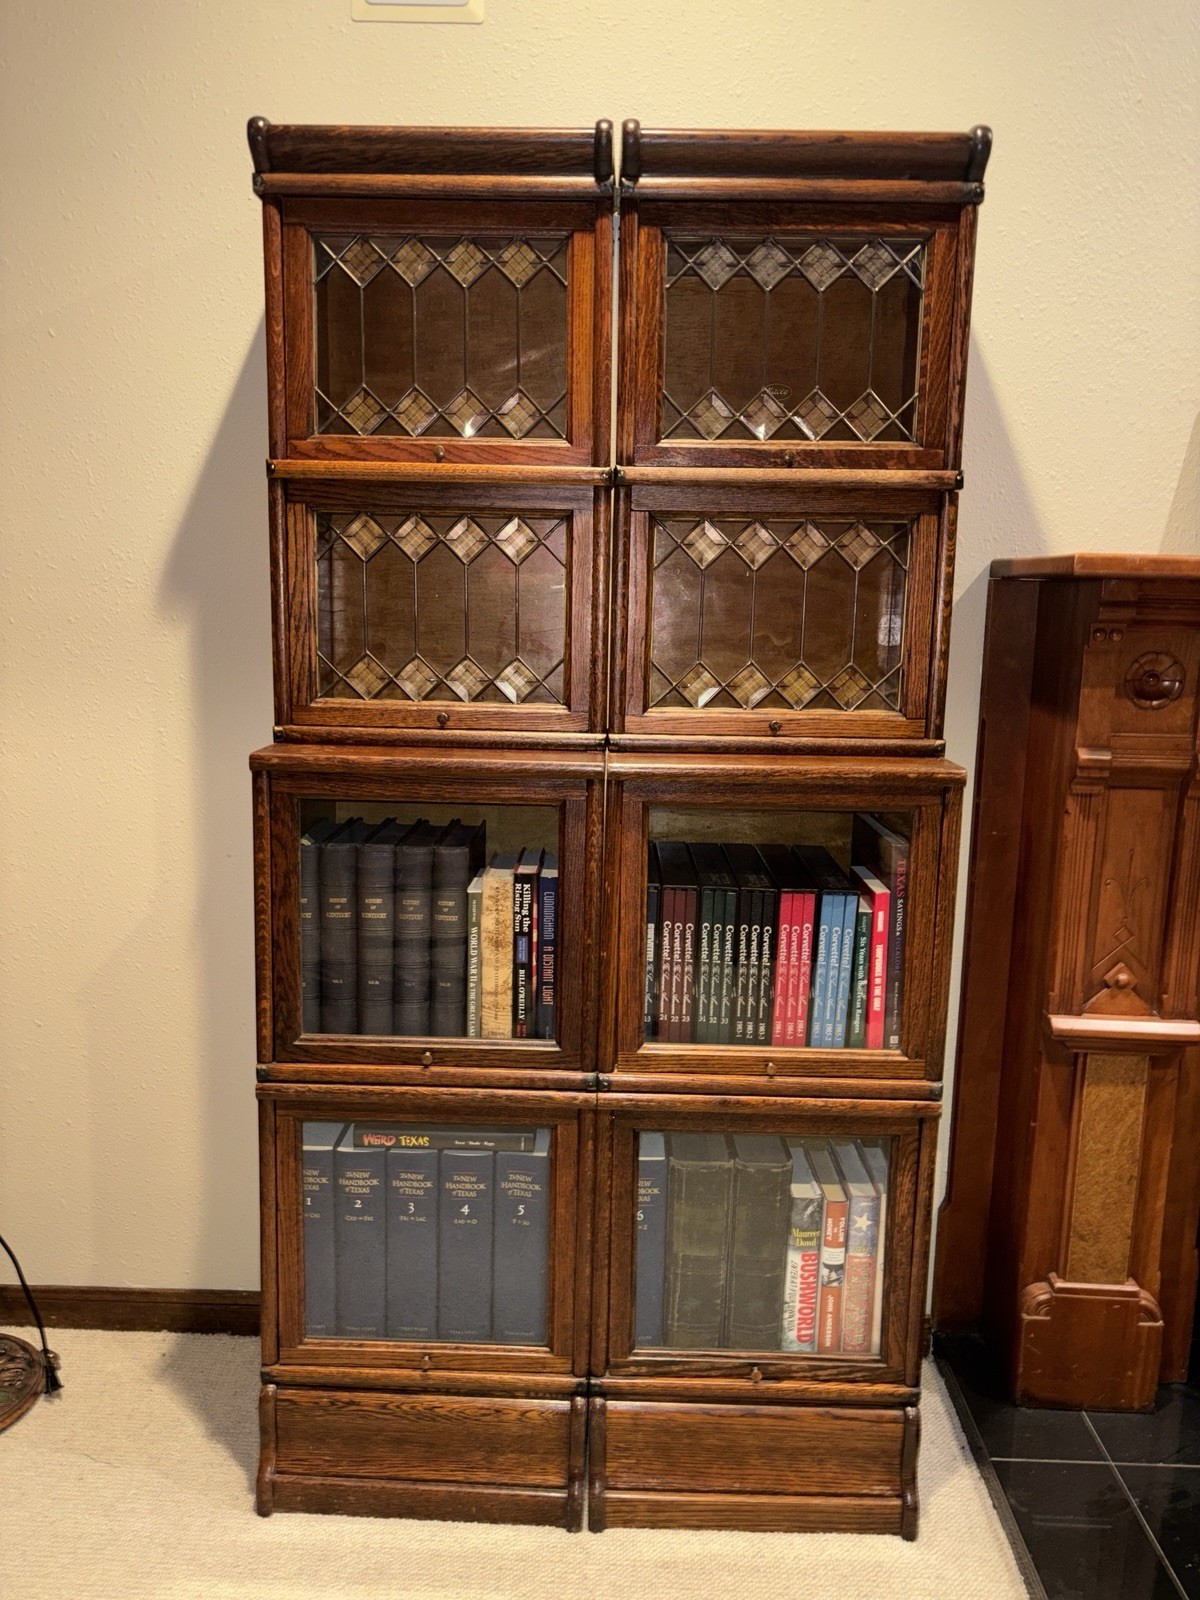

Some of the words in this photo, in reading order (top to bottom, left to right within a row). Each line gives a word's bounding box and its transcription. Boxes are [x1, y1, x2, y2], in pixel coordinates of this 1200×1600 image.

[896, 858, 906, 897] TEXAS
[522, 884, 530, 915] Killing
[543, 892, 554, 940] CUNNINGHAM
[663, 921, 672, 960] Corvette!
[674, 922, 683, 962] Corvette!
[685, 923, 694, 962] Corvette!
[702, 923, 710, 962] Corvette!
[713, 924, 722, 964] Corvette!
[725, 925, 734, 965] Corvette!
[740, 924, 749, 964] Corvette!
[750, 925, 760, 965] Corvette!
[762, 926, 772, 966] Corvette!
[780, 924, 789, 964] Corvette!
[790, 926, 800, 965] Corvette!
[801, 923, 811, 964] Corvette!
[818, 925, 828, 965] Corvette!
[830, 927, 841, 966] Corvette!
[842, 928, 852, 968] Corvette!
[543, 954, 554, 982] DISTANT
[543, 986, 553, 1005] LIGHT
[854, 1009, 862, 1033] Rangers
[398, 1135, 430, 1146] TEXAS
[501, 1182, 541, 1190] HANDBOOK
[408, 1203, 414, 1214] 3
[460, 1204, 470, 1215] 4
[518, 1204, 525, 1215] 5
[637, 1210, 644, 1220] 6
[796, 1238, 816, 1246] Dowd
[797, 1251, 818, 1343] BUSHWORLD
[825, 1313, 833, 1347] ANDERSON
